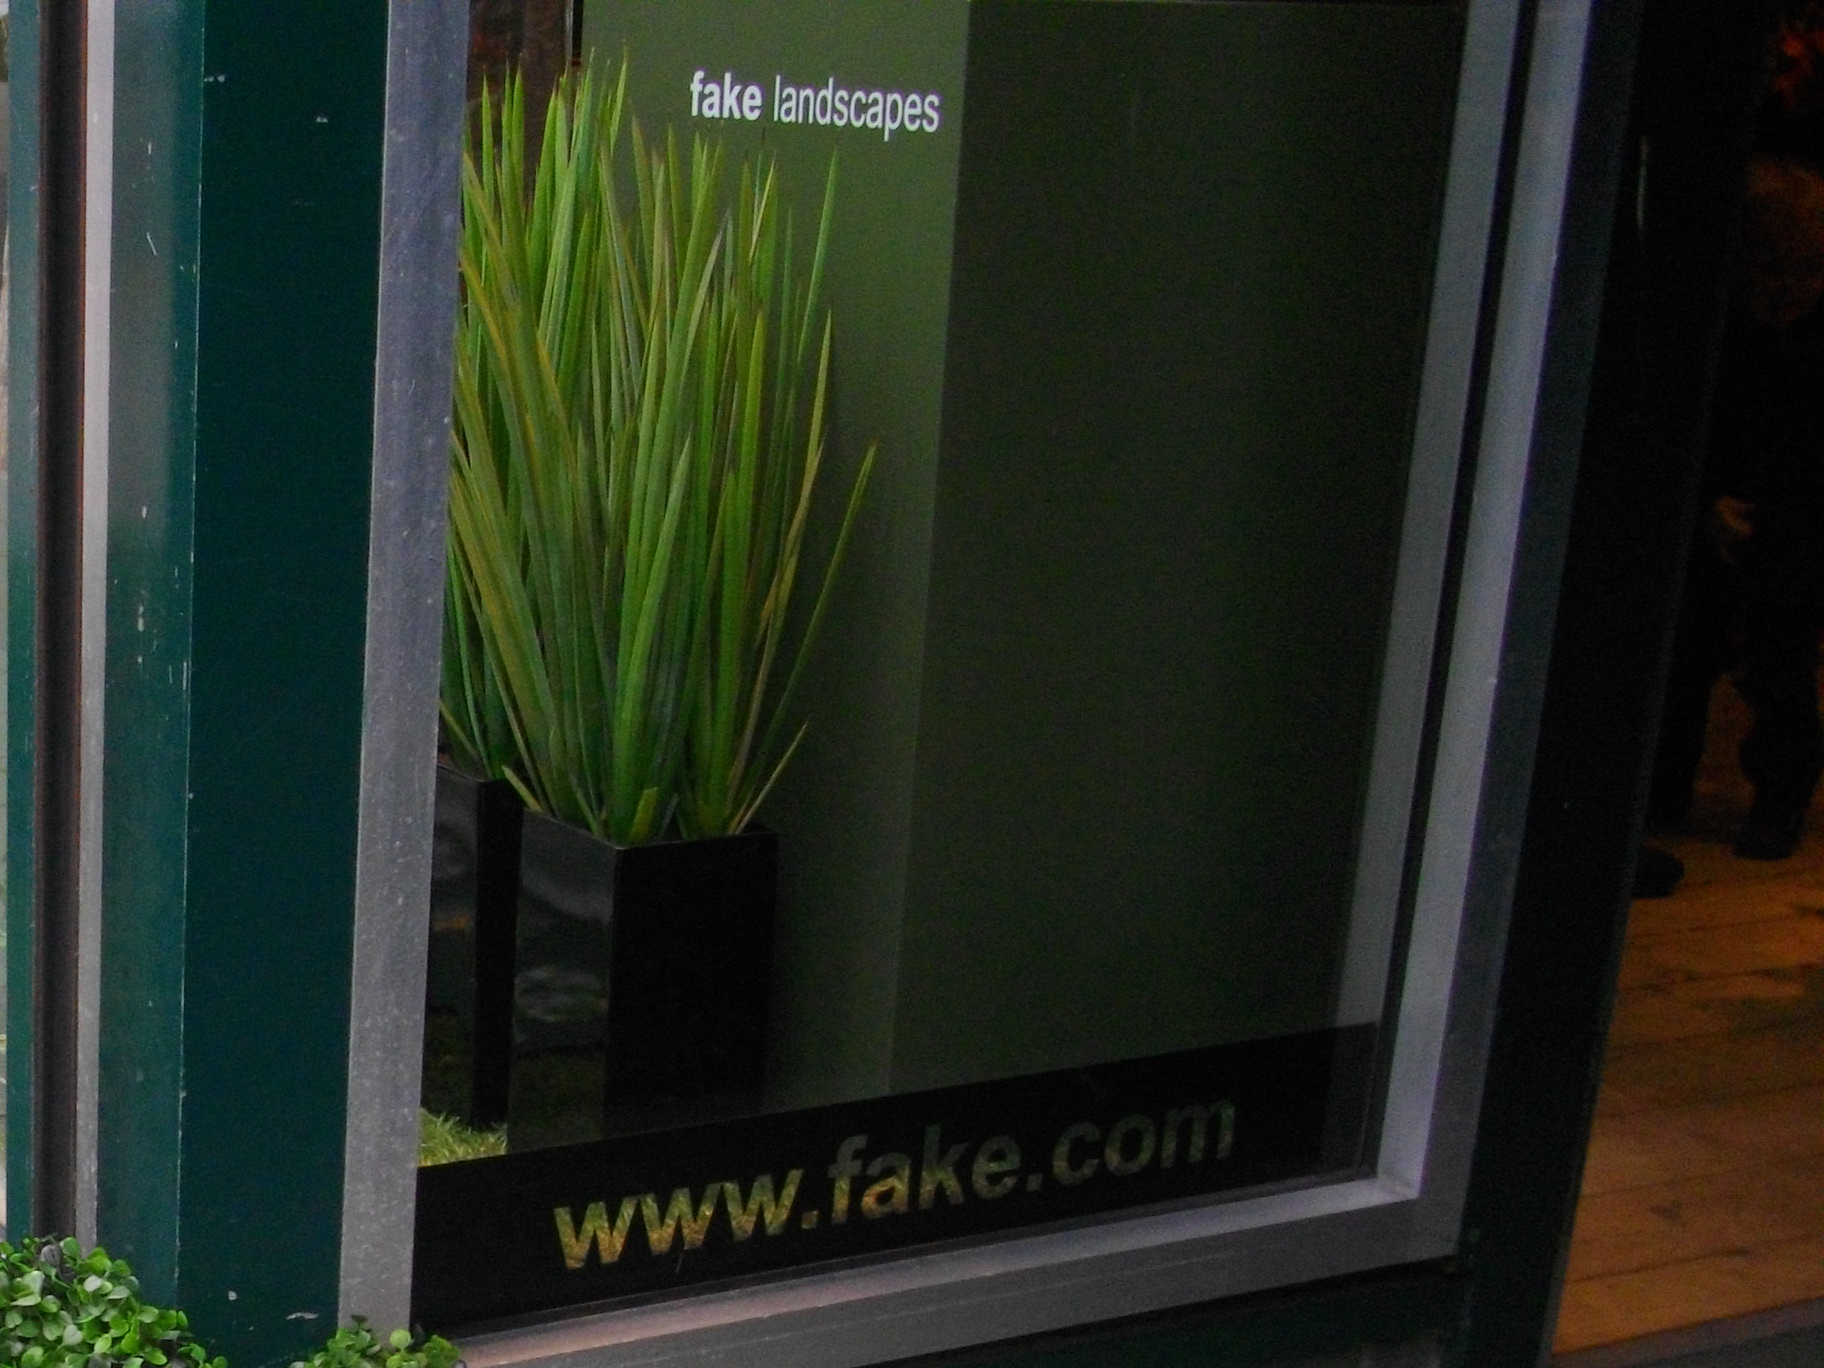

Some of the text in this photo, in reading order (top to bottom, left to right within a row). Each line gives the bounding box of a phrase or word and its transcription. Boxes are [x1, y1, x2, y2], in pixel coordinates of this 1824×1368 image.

[689, 70, 940, 142] fake landscapes
[553, 1098, 1236, 1269] www.fake.com
